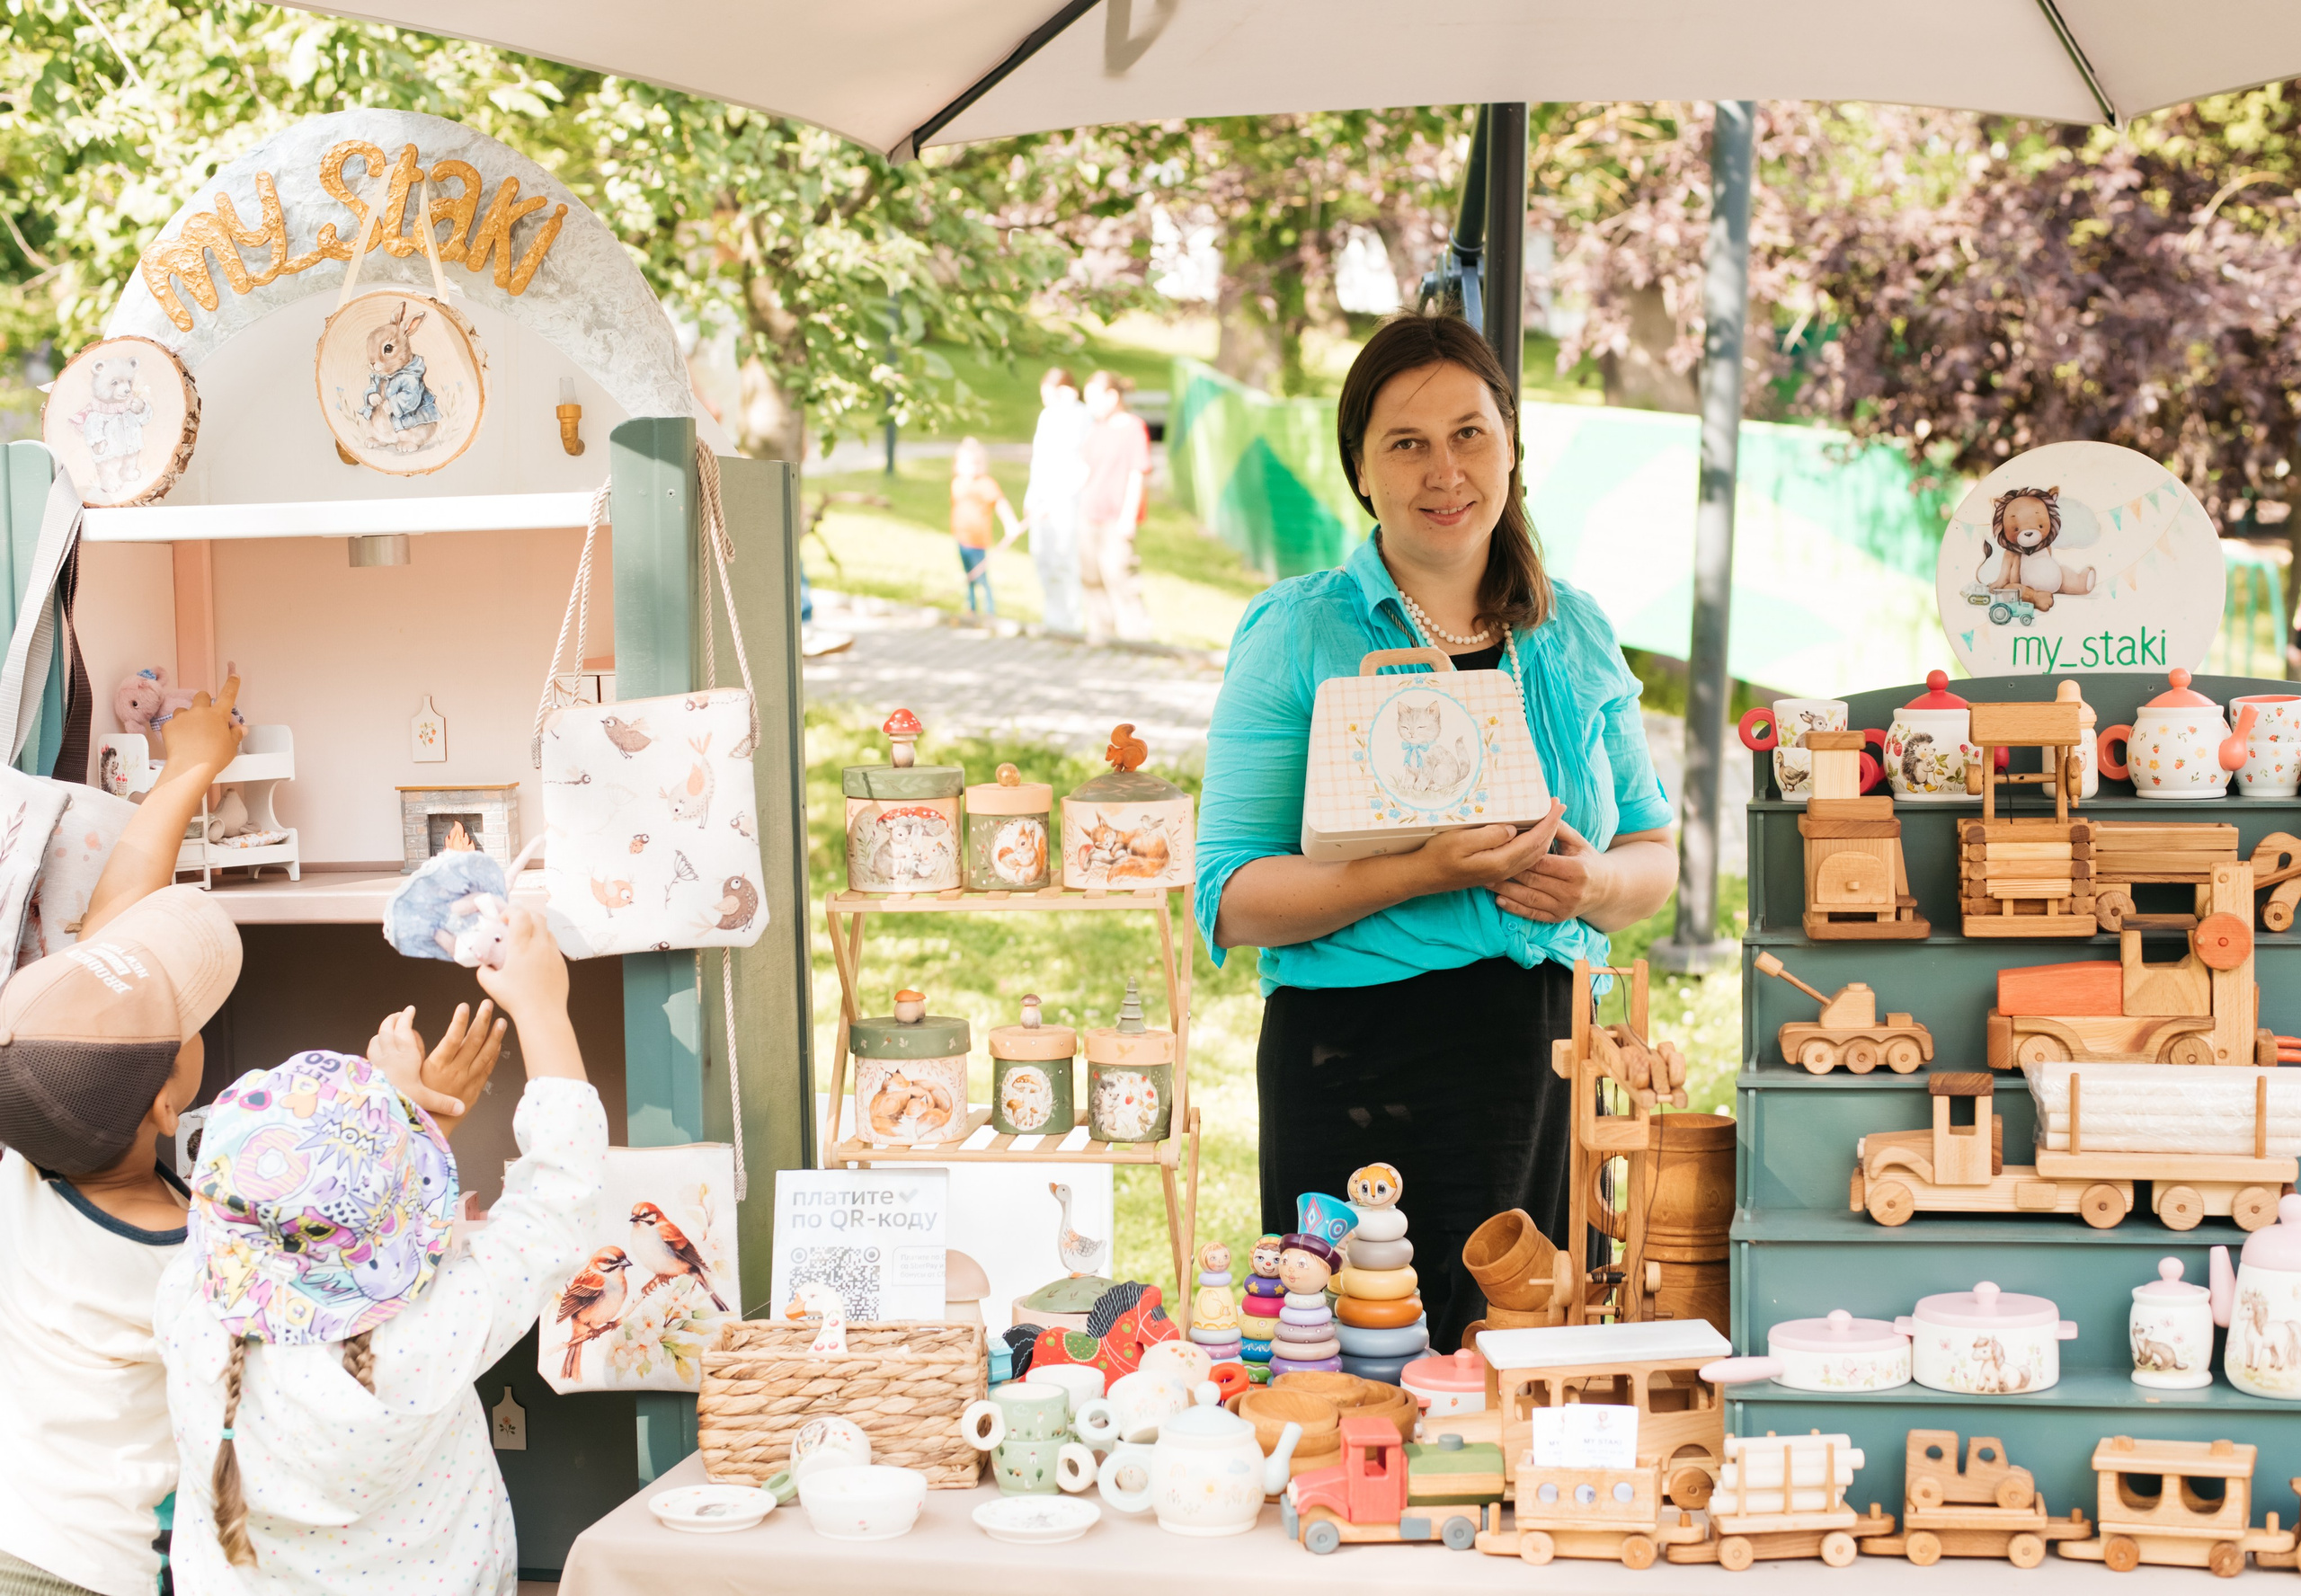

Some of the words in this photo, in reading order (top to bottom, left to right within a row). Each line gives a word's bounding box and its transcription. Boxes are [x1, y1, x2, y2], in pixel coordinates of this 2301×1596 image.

[2012, 625, 2166, 675] my_staki
[305, 1052, 342, 1073] GO
[793, 1191, 894, 1206] платите
[792, 1213, 822, 1228] по
[830, 1210, 937, 1231] QR-коду
